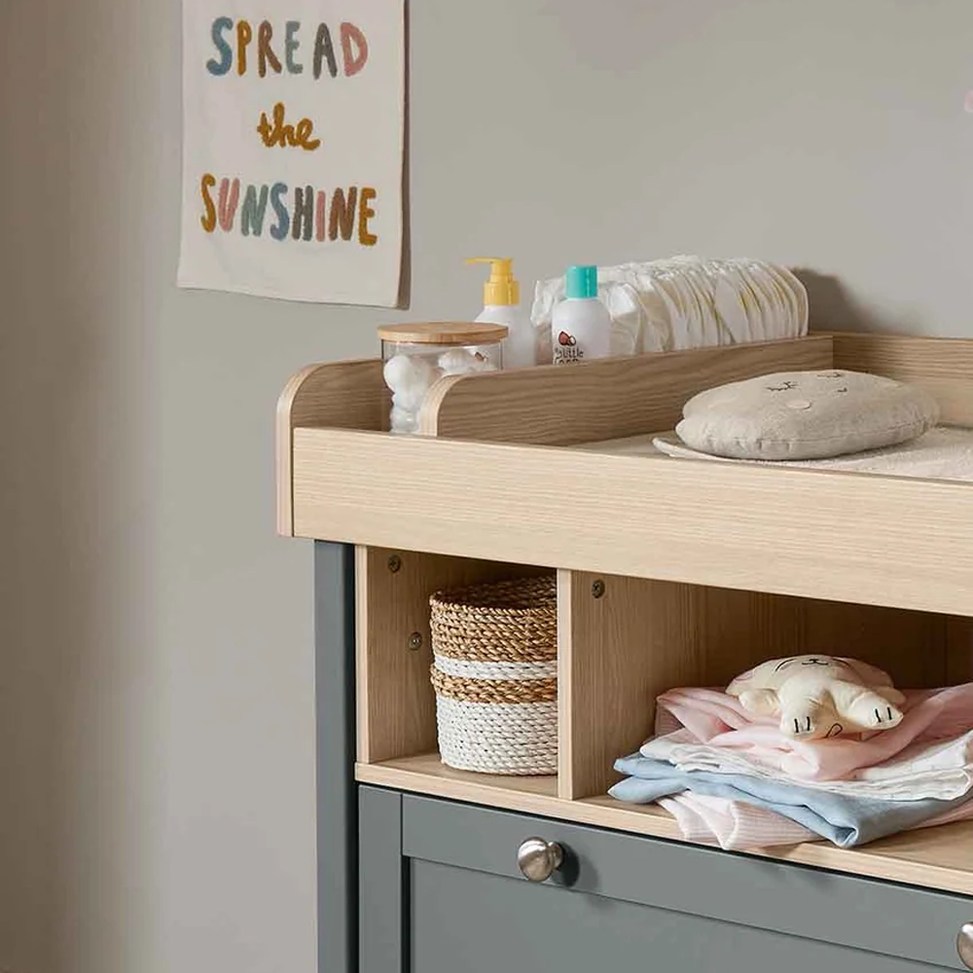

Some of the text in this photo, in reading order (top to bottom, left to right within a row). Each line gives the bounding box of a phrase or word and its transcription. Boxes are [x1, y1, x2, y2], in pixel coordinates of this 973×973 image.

[206, 16, 369, 80] SPREAD
[257, 102, 321, 151] the
[201, 173, 378, 246] SUNSHINE
